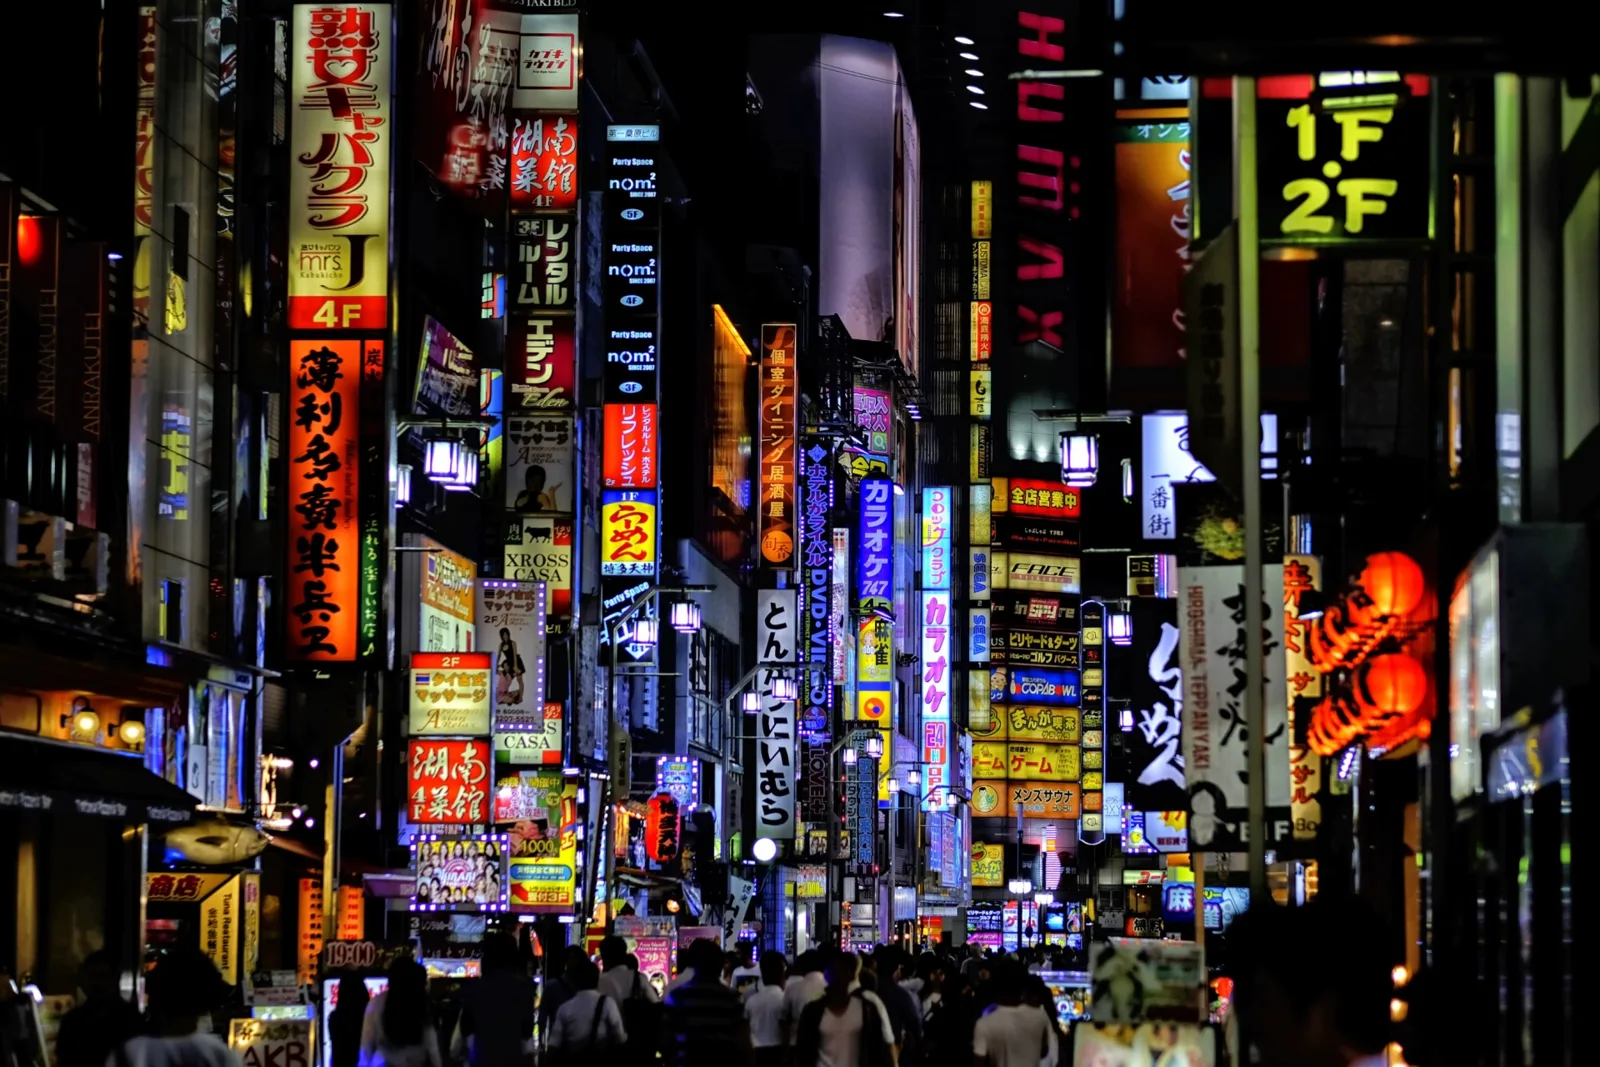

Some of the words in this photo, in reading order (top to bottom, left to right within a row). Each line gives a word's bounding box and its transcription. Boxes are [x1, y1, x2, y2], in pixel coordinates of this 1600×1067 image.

[299, 8, 385, 230] 熟女キャバクラ
[512, 117, 576, 157] 湖南
[1287, 104, 1394, 161] 1F
[612, 158, 631, 167] Party
[632, 158, 653, 167] Space
[512, 158, 576, 195] 菜館
[532, 196, 554, 207] 4F
[1280, 178, 1398, 233] 2F
[626, 210, 639, 218] 5F
[519, 221, 540, 233] 3F
[611, 244, 630, 253] Party
[631, 244, 653, 253] Space
[321, 235, 380, 291] J
[546, 220, 568, 305] レンタル
[517, 244, 540, 305] ルーム
[625, 297, 638, 305] 4F
[313, 301, 363, 328] 4F
[611, 331, 629, 339] Party
[631, 331, 652, 340] Space
[526, 320, 554, 384] エデン
[82, 312, 101, 437] ANRAKUTEI
[523, 387, 570, 408] Eden
[642, 405, 651, 452] レンタルルーム
[769, 349, 786, 517] 個室ダイニング居酒屋
[621, 405, 637, 487] リフレッシュ
[641, 456, 651, 483] ホステル
[621, 492, 639, 501] 1F
[1011, 488, 1077, 510] 全店営業中
[1150, 472, 1171, 536] 一番街
[806, 464, 827, 567] ホテルがライバル
[509, 523, 519, 534] 肉
[610, 505, 649, 560] らーめん
[864, 481, 889, 577] カラオケ
[506, 553, 569, 567] XROSS
[603, 563, 653, 575] 博多天神
[1011, 562, 1078, 577] FACE
[514, 568, 562, 582] CASA
[973, 553, 987, 594] SEGA
[604, 592, 625, 609] Party
[624, 581, 650, 603] Space
[862, 581, 888, 595] 747
[484, 615, 498, 624] 2F
[874, 618, 889, 666] 麻雀
[973, 615, 987, 656] SEGA
[991, 638, 1005, 646] US
[1009, 632, 1078, 649] ビリヤード&ダーツ
[442, 657, 461, 667] 2F
[924, 597, 947, 712] カラオケ
[1054, 653, 1078, 665] バグース
[433, 672, 487, 687] タイ古式
[415, 689, 487, 703] マッサージ
[1011, 708, 1077, 731] まんが喫茶
[504, 736, 551, 749] CASA
[926, 724, 944, 747] 24
[413, 743, 486, 783] 湖南
[931, 749, 940, 762] H
[1010, 755, 1053, 774] ゲーム
[429, 787, 485, 822] 菜館
[1012, 789, 1073, 803] メンズサウナ
[858, 758, 873, 864] 歌舞伎町案内所
[222, 893, 232, 914] Tuna
[221, 916, 231, 971] Restaurant
[327, 941, 376, 967] 19:00
